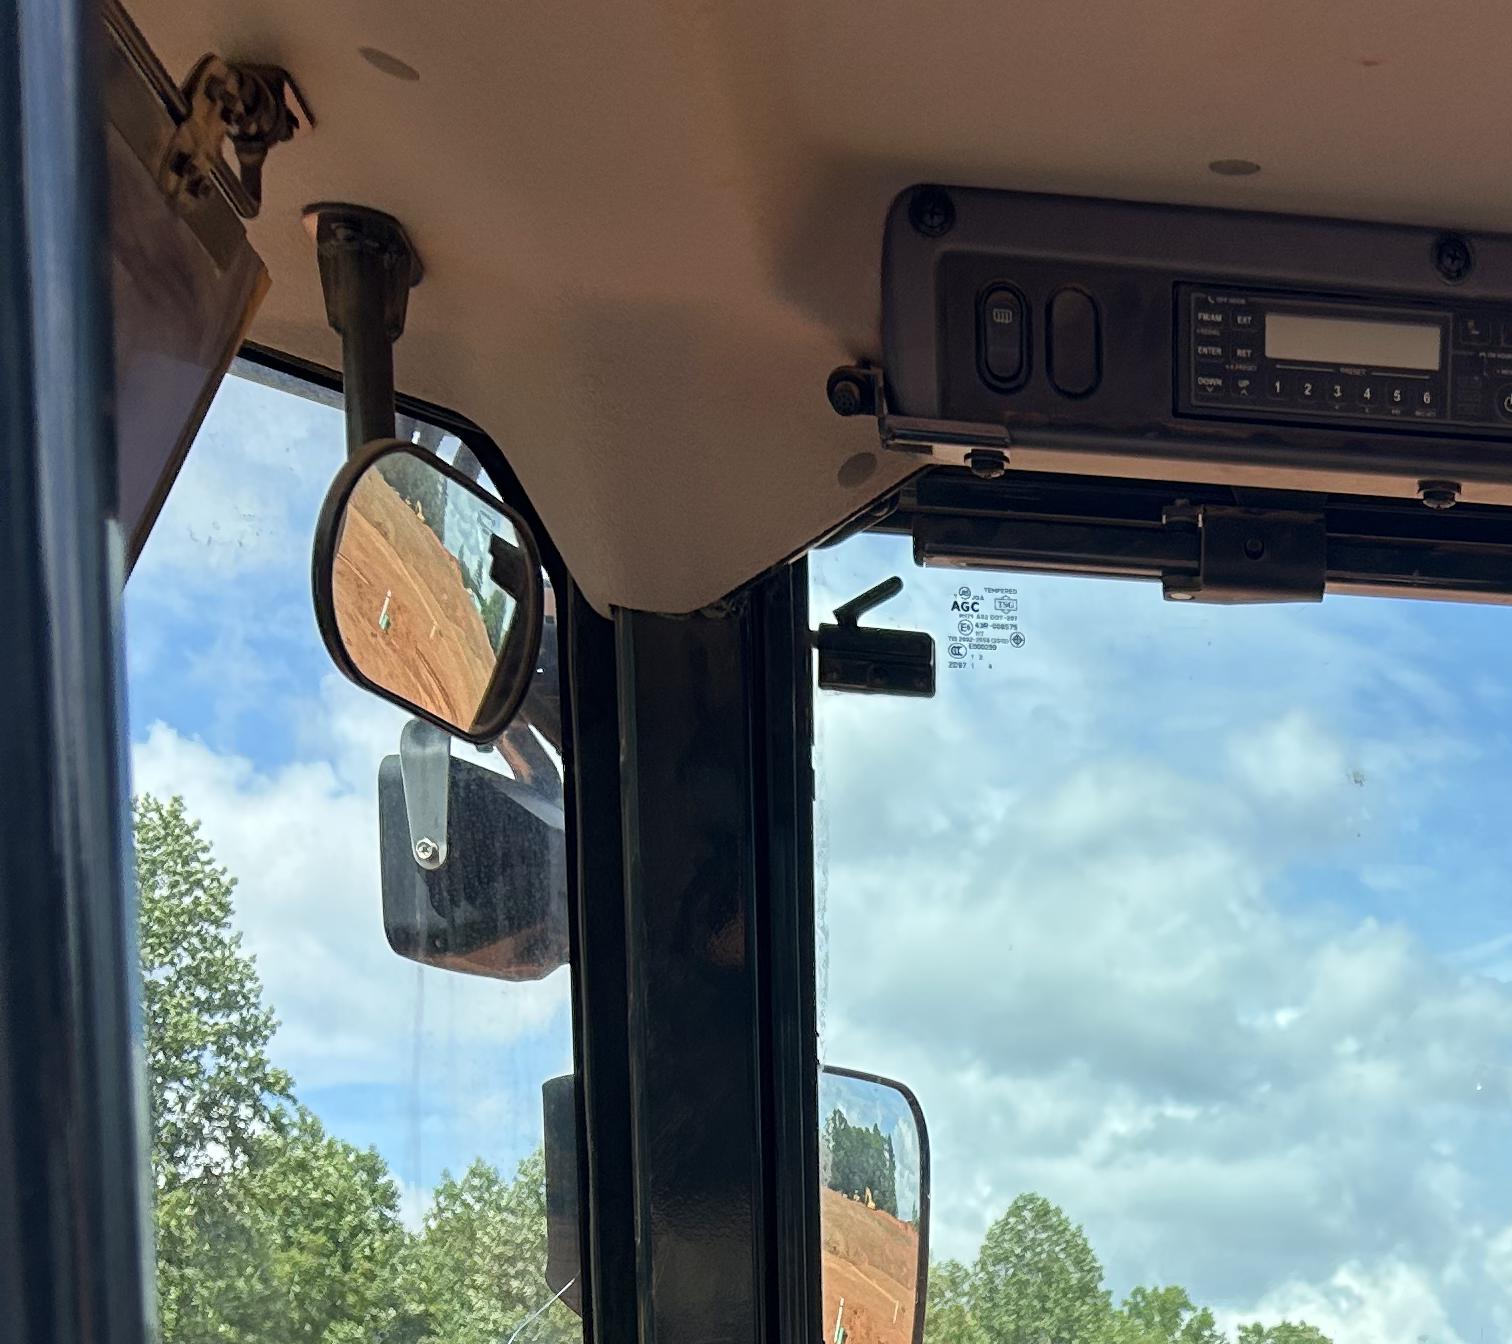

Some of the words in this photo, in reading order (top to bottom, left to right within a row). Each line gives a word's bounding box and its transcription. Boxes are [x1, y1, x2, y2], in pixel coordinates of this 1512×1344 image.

[1198, 346, 1222, 356] ENTER
[1198, 376, 1223, 387] DOWN
[1274, 380, 1281, 393] 1
[1303, 382, 1312, 396] 2
[1333, 384, 1343, 397] 3
[1363, 387, 1372, 401] 4
[1393, 389, 1402, 402] 5
[1423, 391, 1432, 404] 6
[951, 601, 980, 612] AGC
